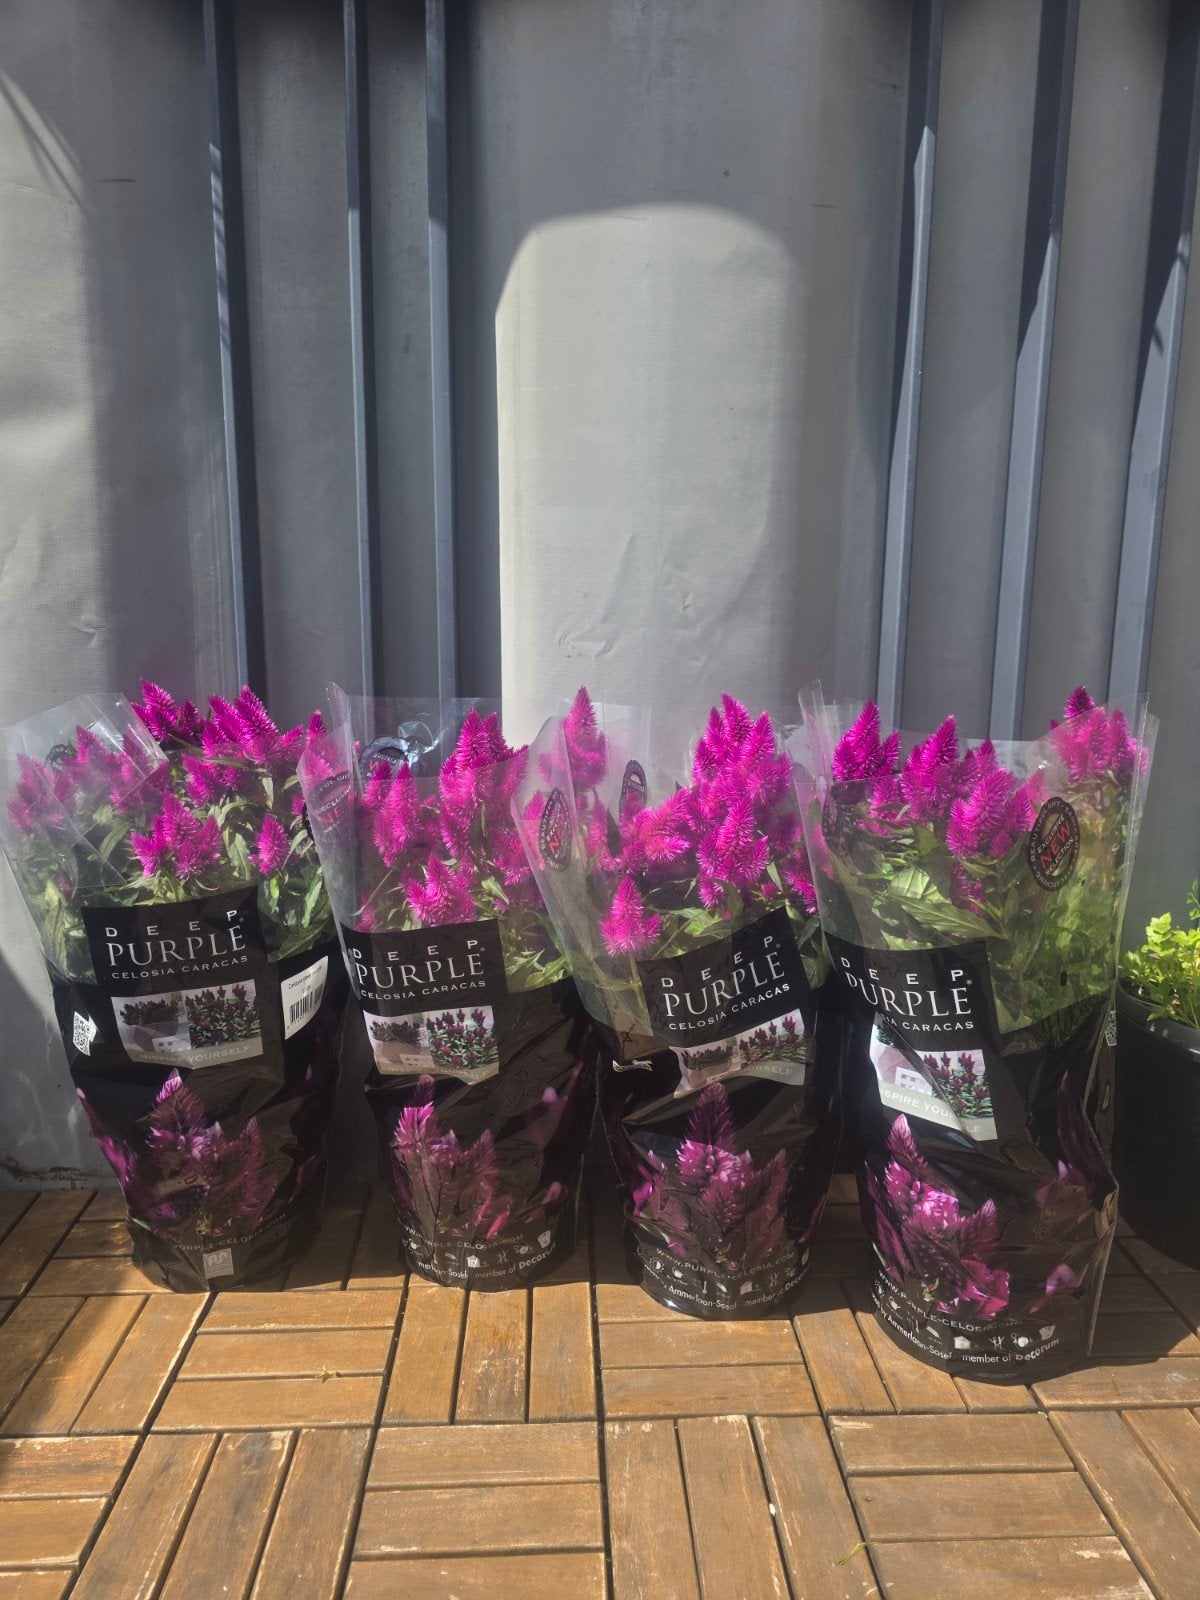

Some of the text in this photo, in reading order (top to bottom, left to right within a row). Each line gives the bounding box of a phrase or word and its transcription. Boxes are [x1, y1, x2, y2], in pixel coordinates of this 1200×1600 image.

[1038, 814, 1065, 854] EXCLUSIVE
[1041, 821, 1071, 869] NEW
[1046, 837, 1073, 875] SELECTION
[106, 925, 246, 967] PURPLE
[111, 955, 248, 980] CELOSIA CARACAS
[355, 954, 484, 989] PURPLE
[663, 951, 785, 1018] PURPLE
[361, 980, 486, 1001] CELOSIA CARACAS
[669, 983, 790, 1030] CELOSIA CARACAS
[844, 971, 971, 1018] PURPLE
[902, 1021, 974, 1032] CARACAS
[187, 1045, 251, 1062] YOURSELF
[962, 1354, 999, 1363] member
[1002, 1353, 1011, 1362] of
[1015, 1338, 1060, 1361] Decorum
